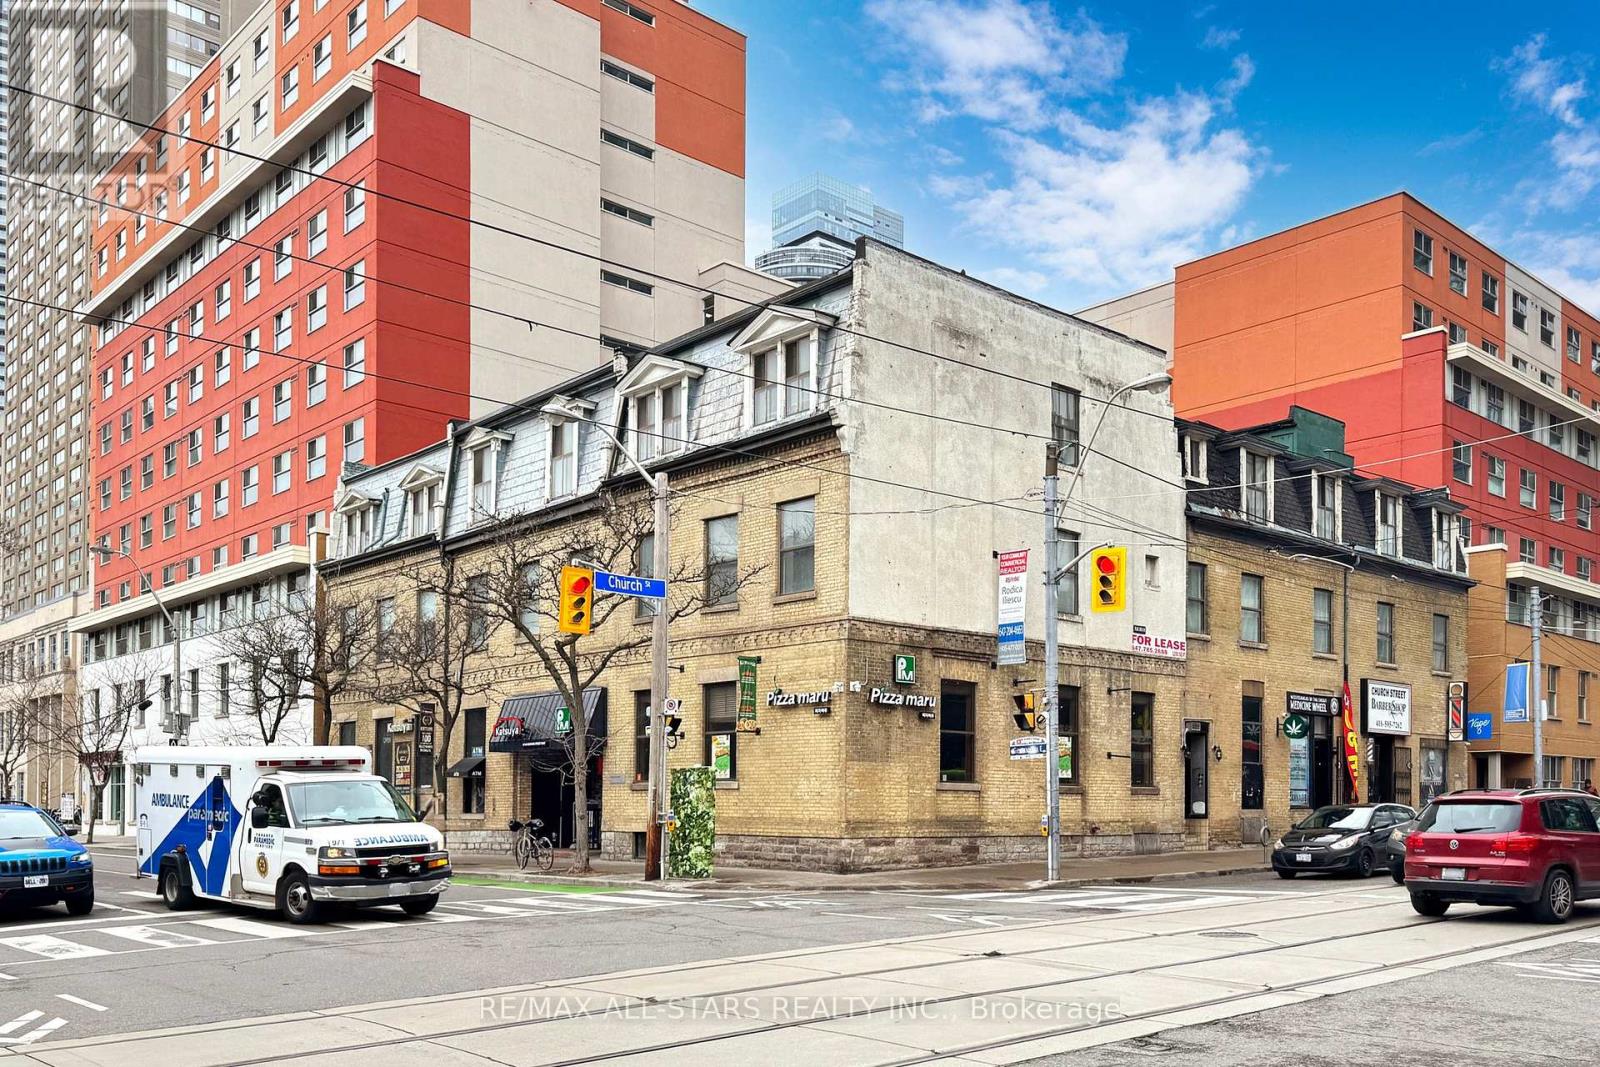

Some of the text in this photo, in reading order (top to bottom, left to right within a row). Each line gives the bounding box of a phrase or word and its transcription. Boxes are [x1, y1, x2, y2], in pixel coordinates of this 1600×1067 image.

[608, 576, 643, 592] Church
[1002, 586, 1023, 596] Rodica
[1132, 634, 1186, 652] FOR LEASE
[767, 690, 829, 706] Pizza maru
[871, 687, 937, 708] Pizza maru
[1371, 686, 1407, 699] CHURCH STREET
[1290, 700, 1328, 713] MEDICINE WHEEL
[1468, 717, 1491, 735] Vape
[151, 792, 190, 808] AMBULANCE
[187, 806, 230, 823] paramedic
